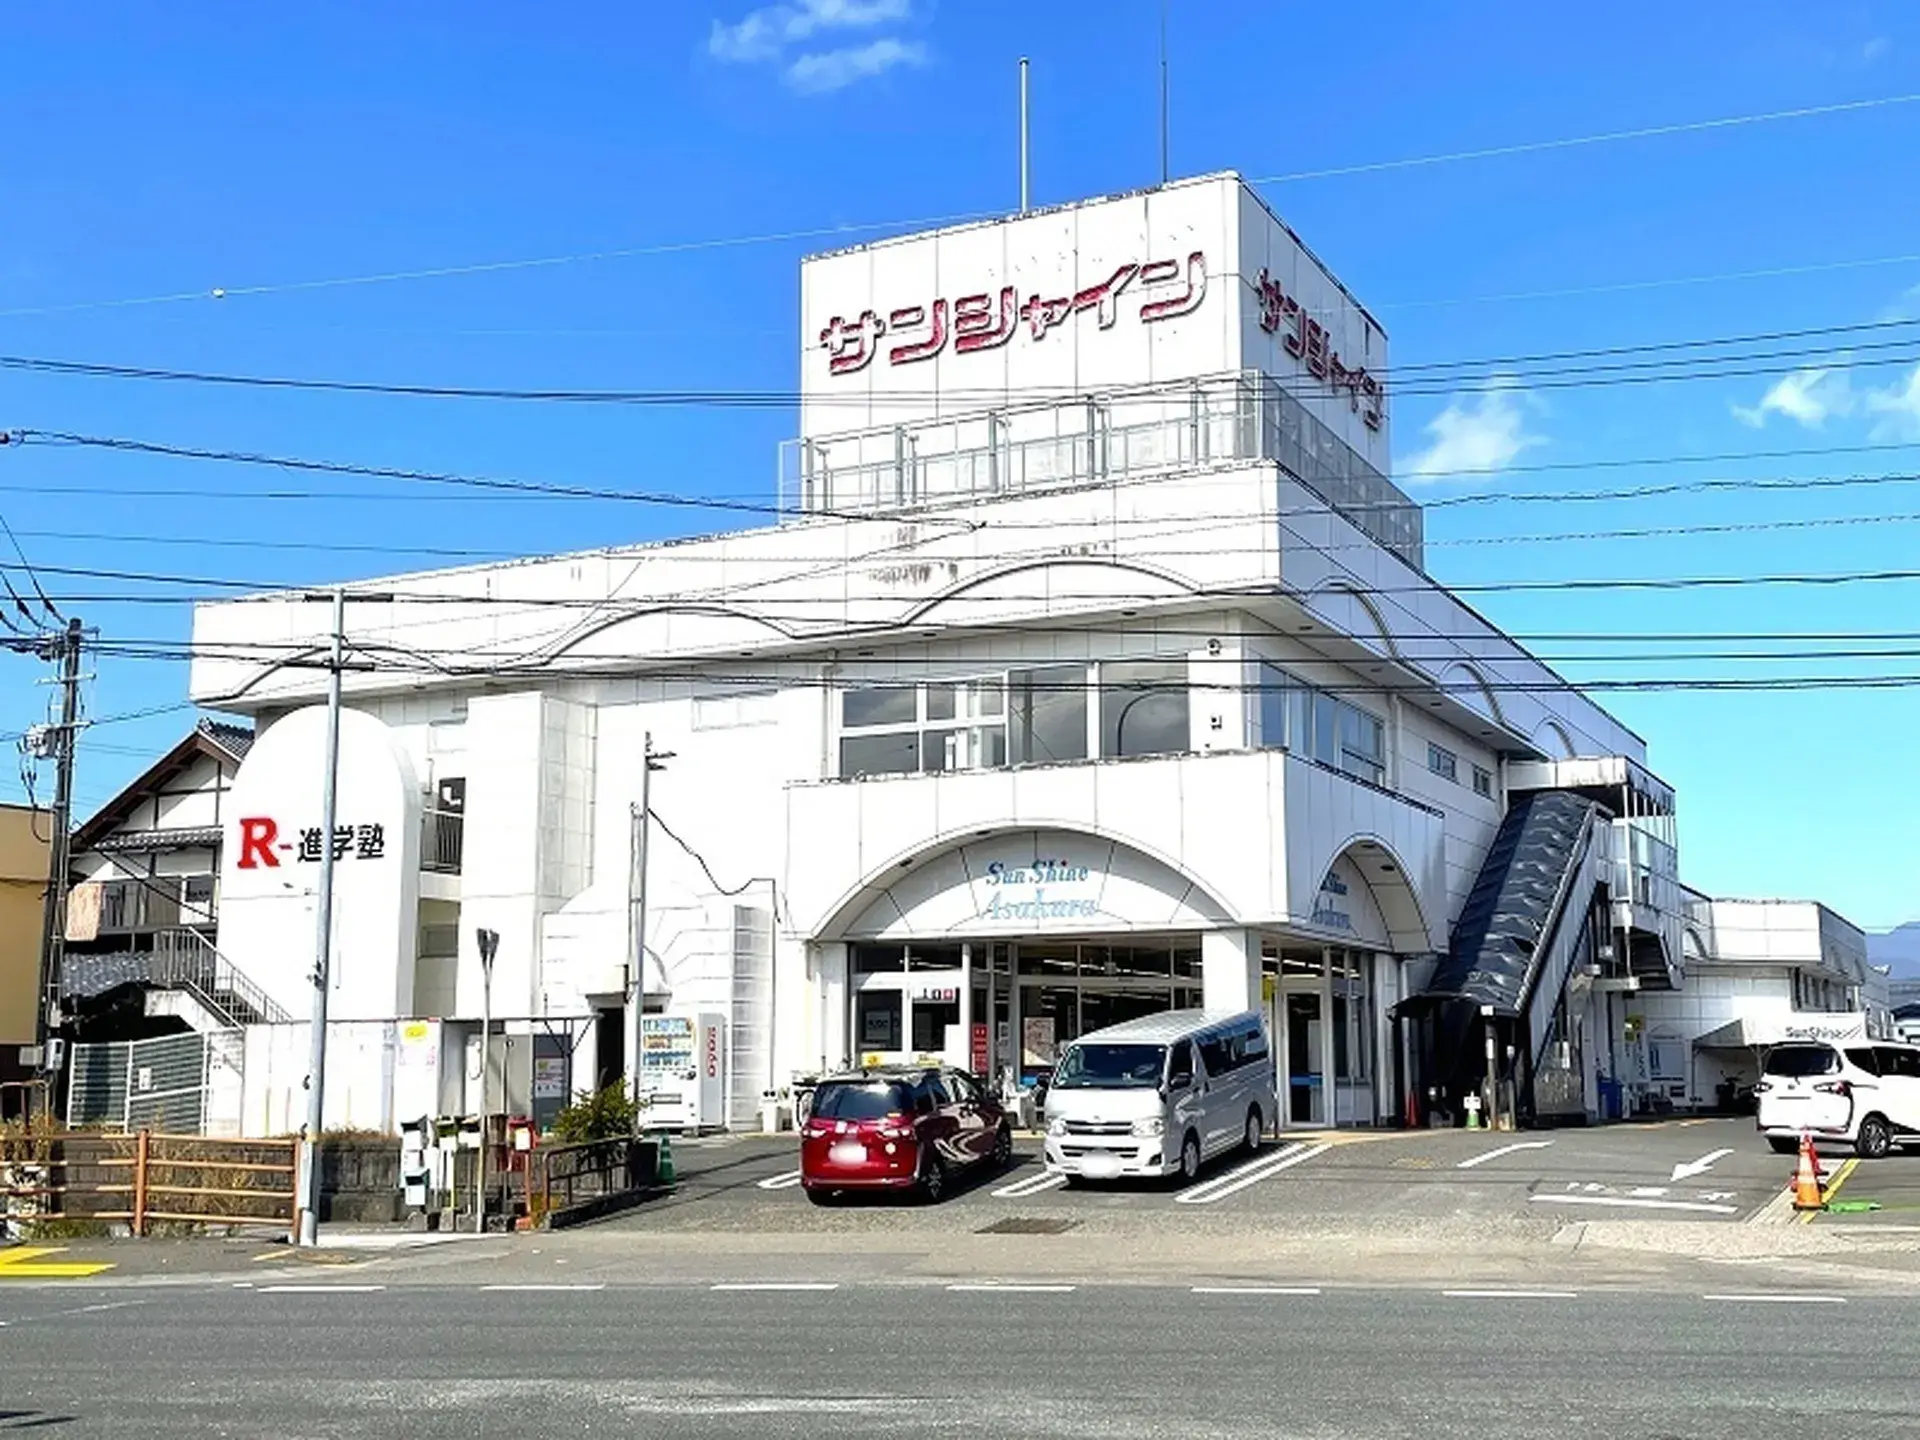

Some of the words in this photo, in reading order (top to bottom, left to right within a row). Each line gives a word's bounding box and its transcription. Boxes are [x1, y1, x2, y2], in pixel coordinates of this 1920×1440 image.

[820, 251, 1207, 376] サンシャイン
[1253, 267, 1384, 431] サンシャイン
[978, 887, 1097, 920] Asakura
[985, 860, 1026, 886] Sun
[1029, 858, 1089, 884] Shine
